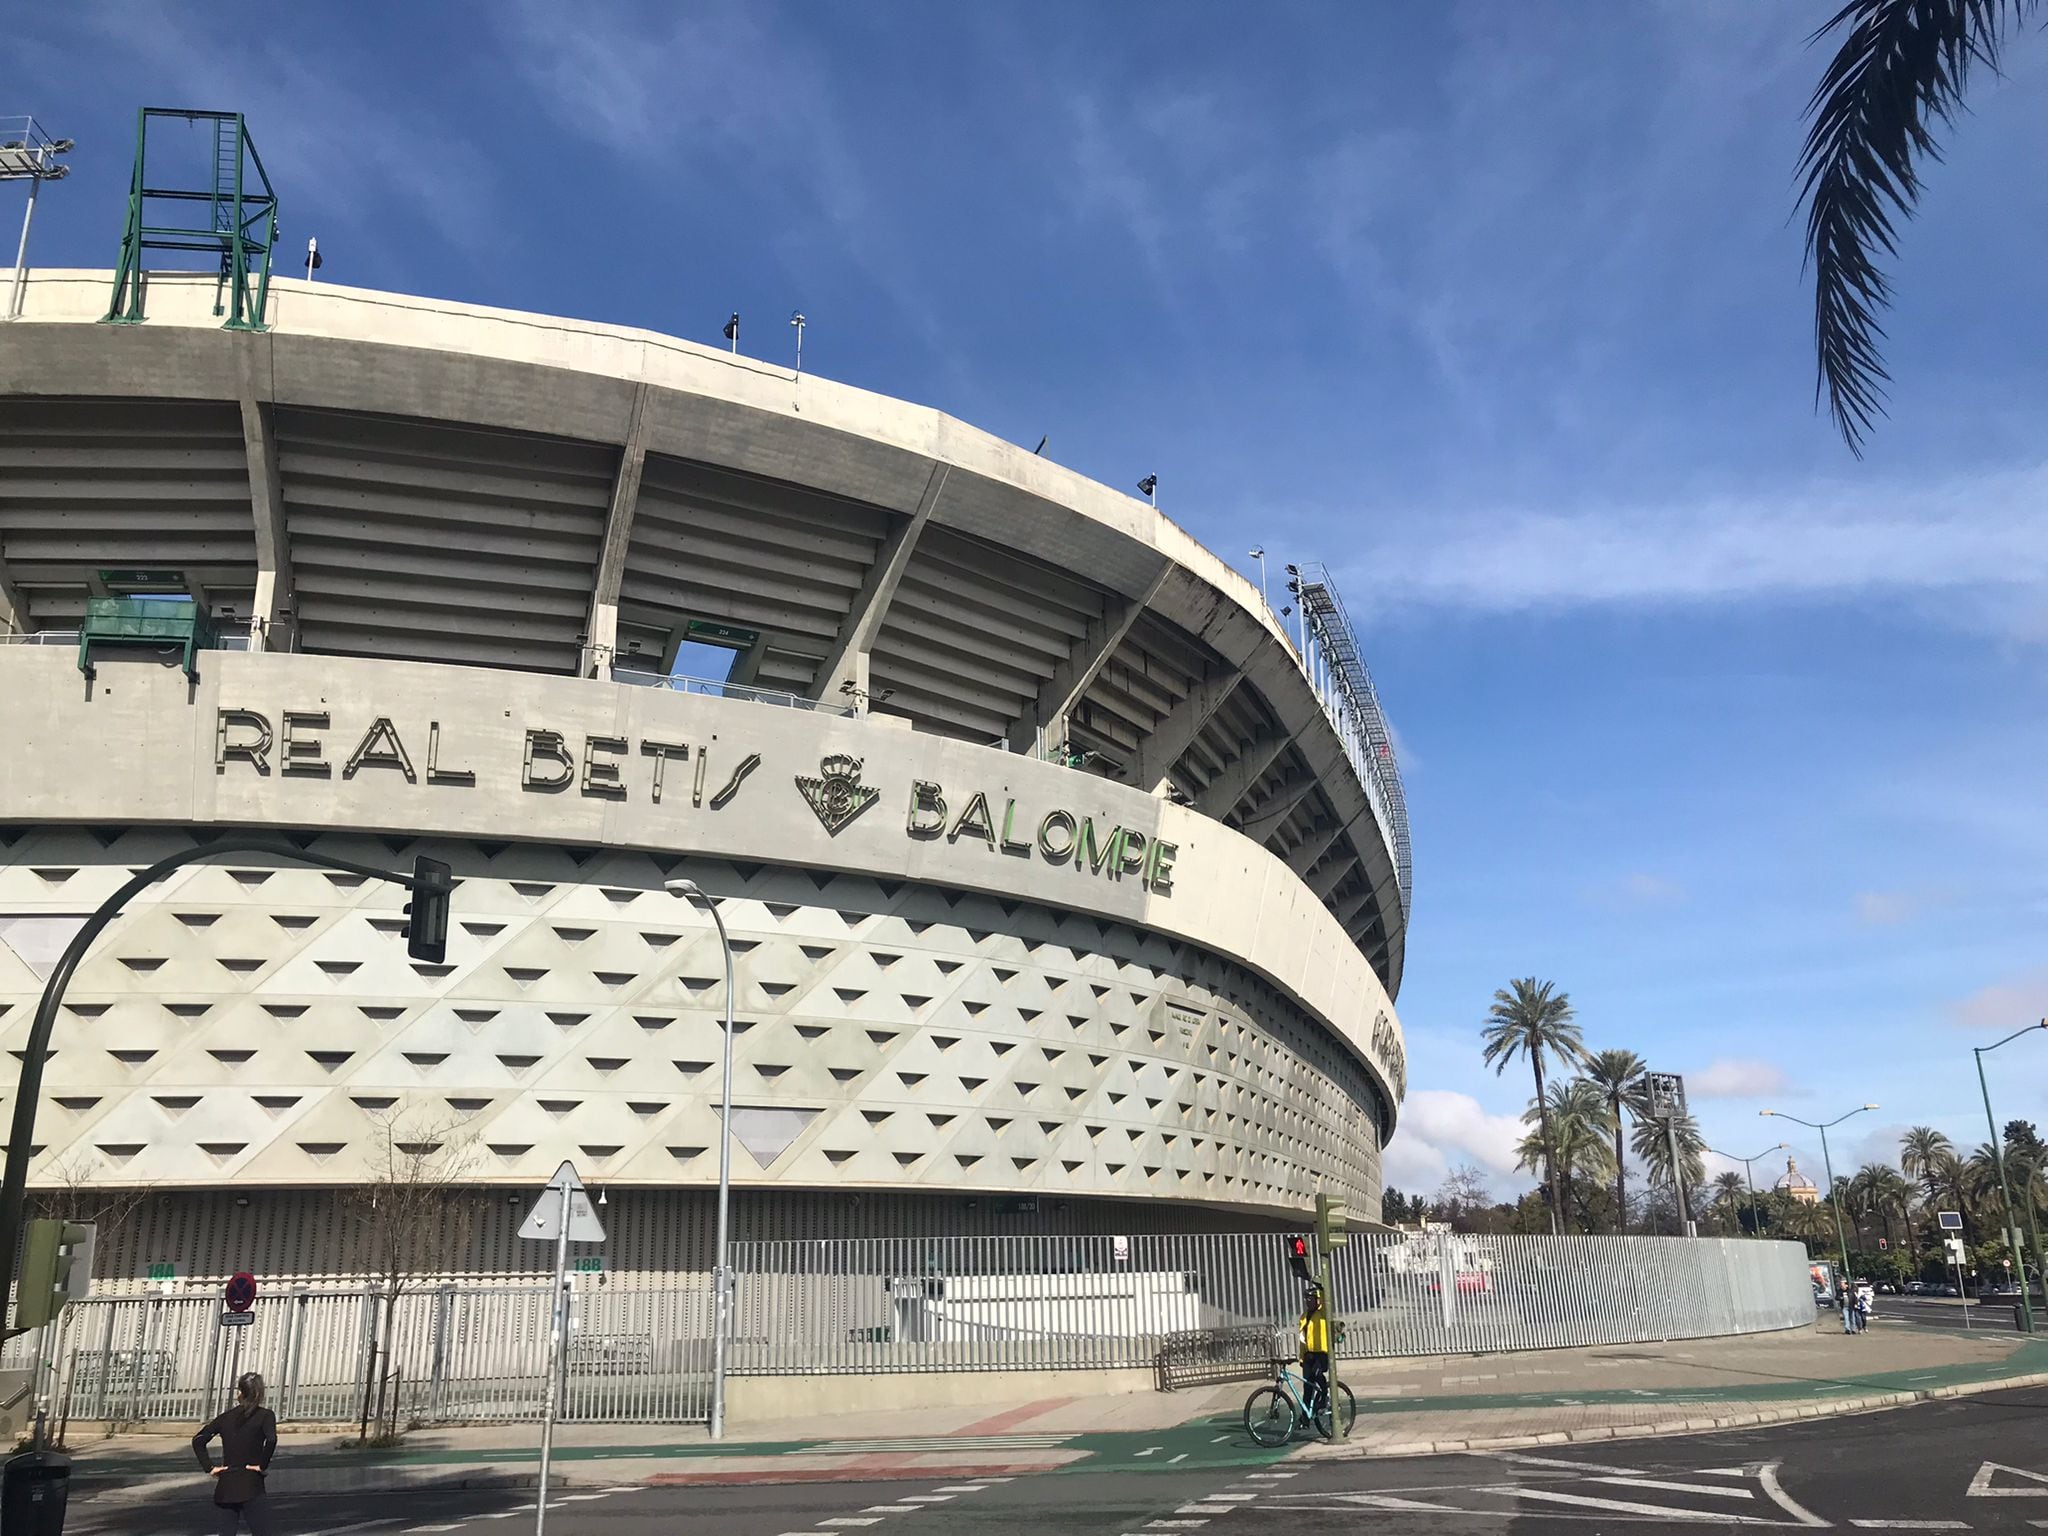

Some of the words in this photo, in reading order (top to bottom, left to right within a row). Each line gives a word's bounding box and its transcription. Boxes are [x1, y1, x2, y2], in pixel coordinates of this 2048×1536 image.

[215, 706, 476, 788] REAL
[906, 778, 1179, 895] BALOMPIE
[146, 1263, 175, 1280] 18A
[574, 1258, 602, 1272] 18B
